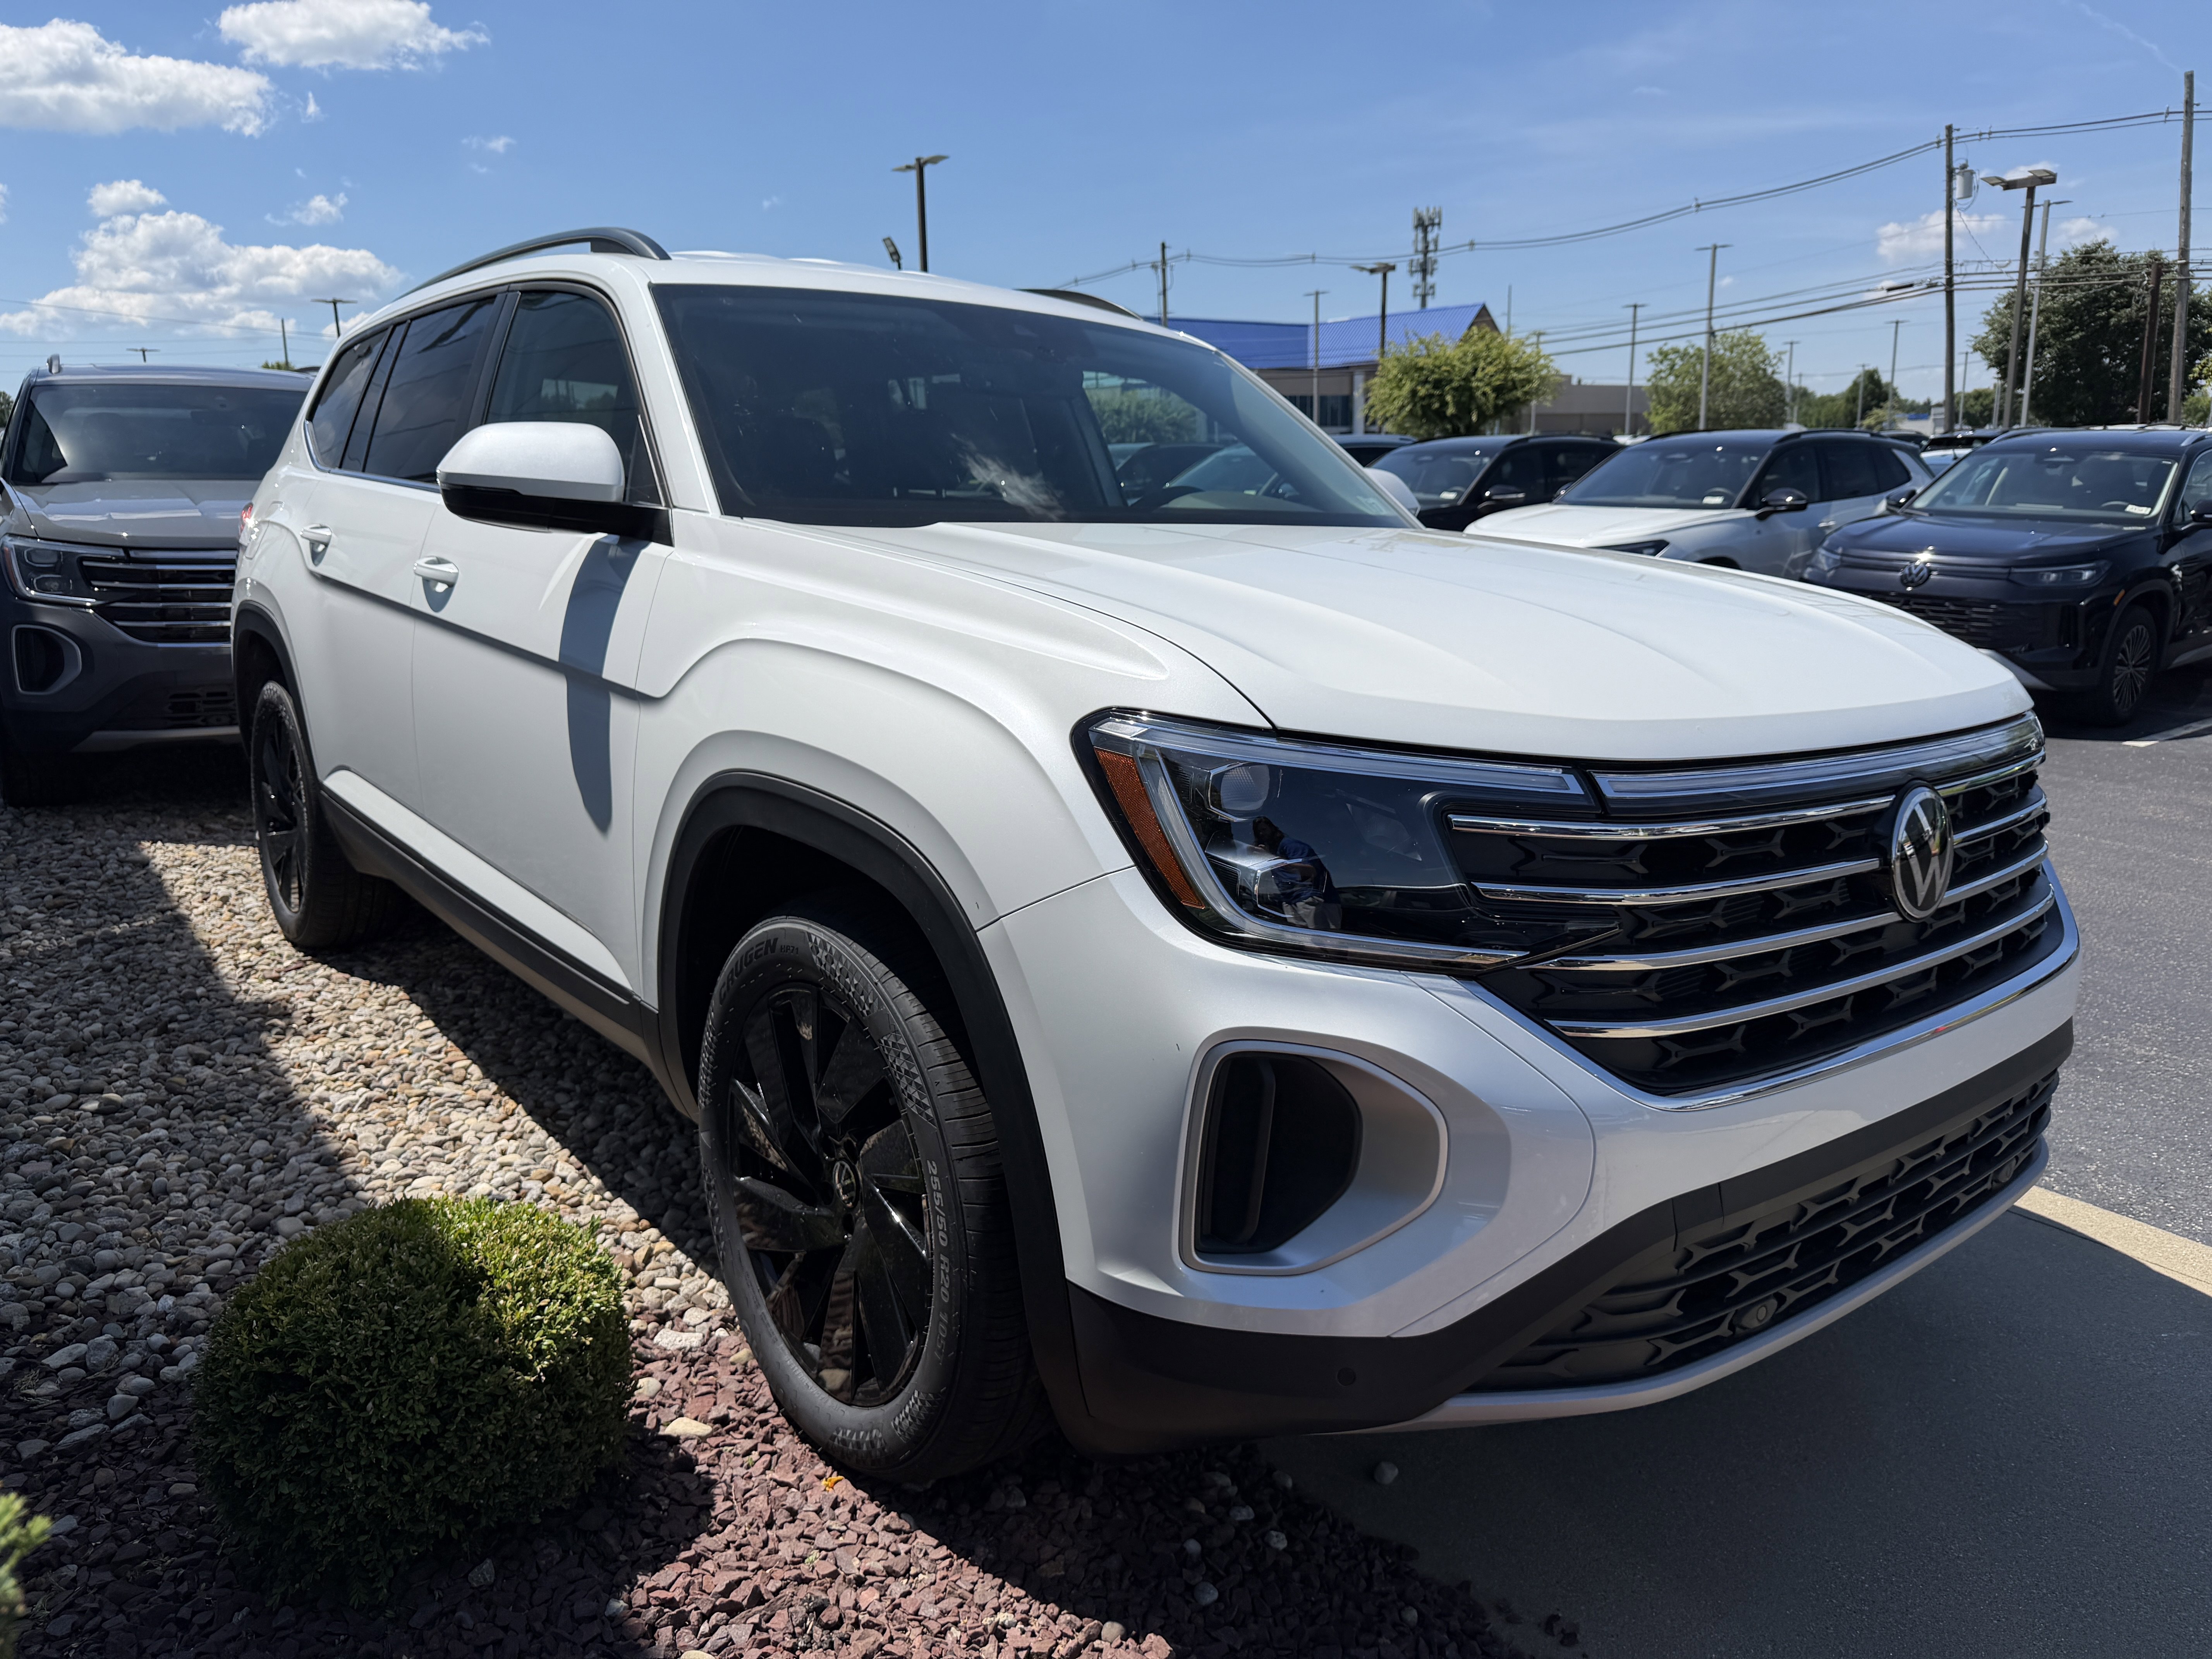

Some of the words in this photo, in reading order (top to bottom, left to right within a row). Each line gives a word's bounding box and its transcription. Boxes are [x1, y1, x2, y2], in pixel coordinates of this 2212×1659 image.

[1899, 562, 1928, 586] VW
[1894, 788, 1952, 920] VW
[719, 937, 778, 1006] CRUGEN
[780, 945, 799, 955] HP71
[927, 1159, 948, 1247] 255/50
[940, 1253, 950, 1303] R20
[934, 1311, 948, 1365] 105T
